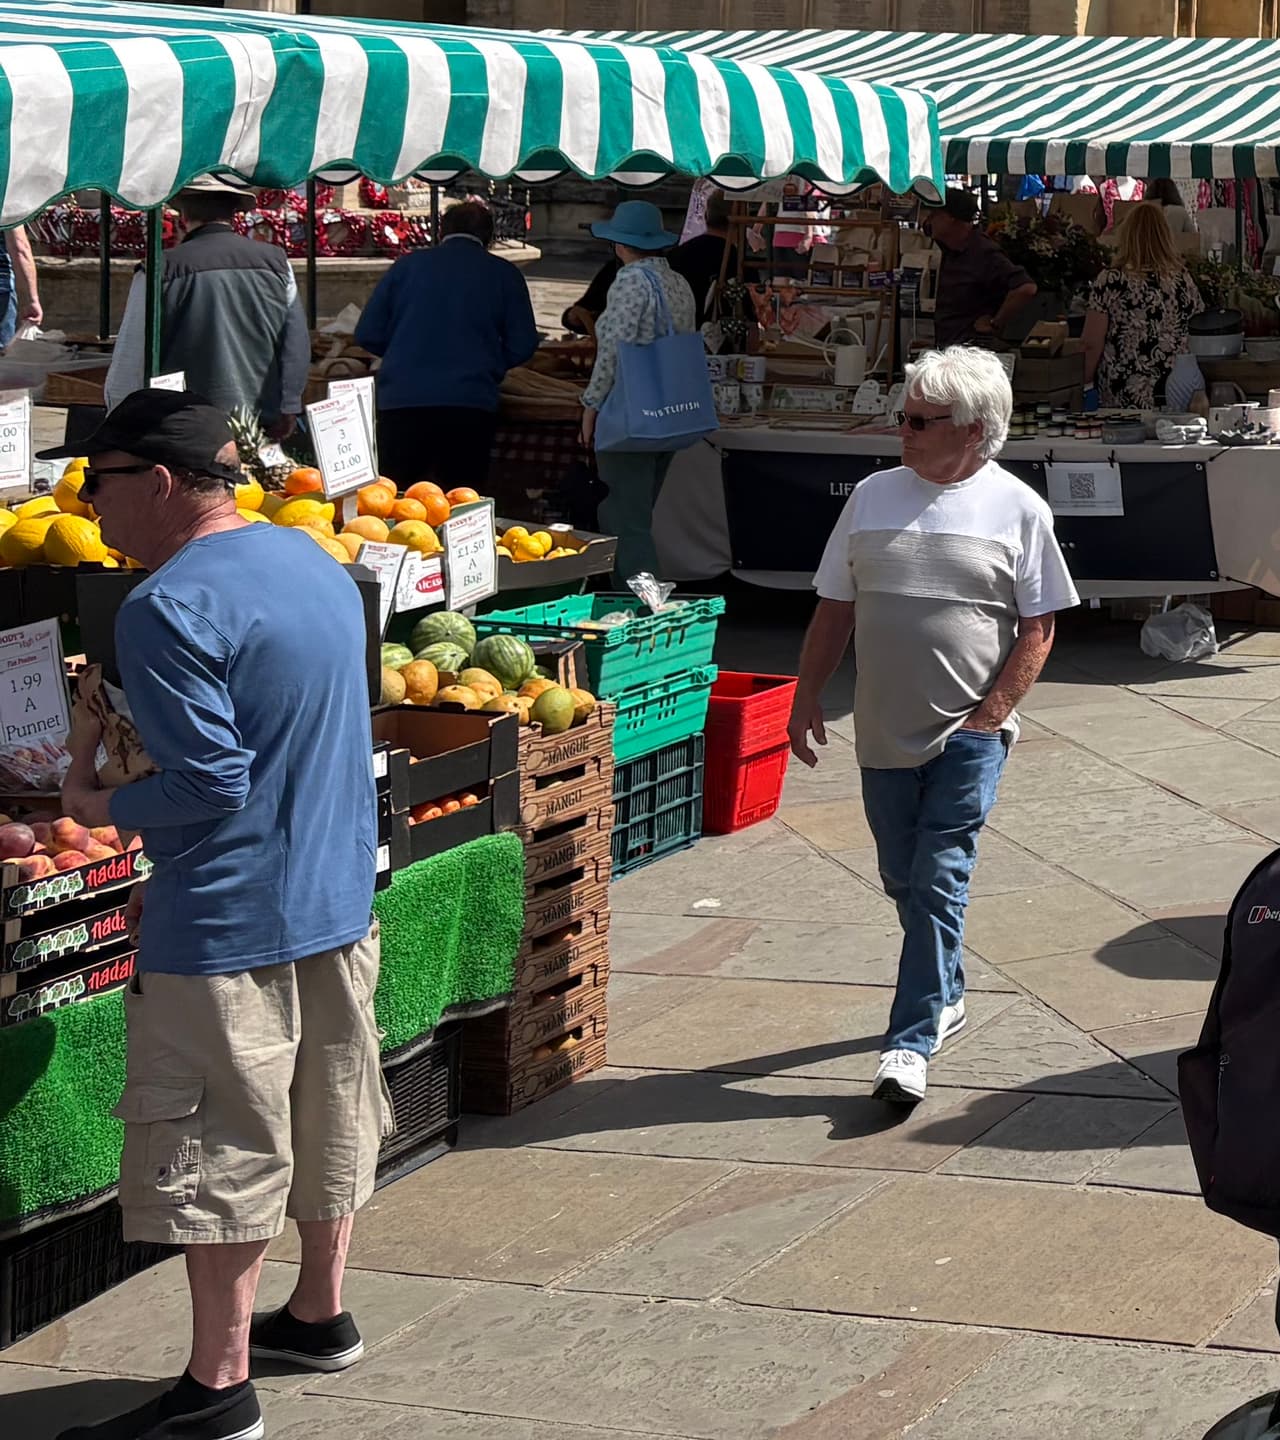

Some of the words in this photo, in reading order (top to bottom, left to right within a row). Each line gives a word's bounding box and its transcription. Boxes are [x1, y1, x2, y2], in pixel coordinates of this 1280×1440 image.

[339, 429, 346, 440] 3
[337, 442, 353, 456] for
[332, 454, 361, 473] £1.00
[829, 482, 857, 496] LIF
[457, 539, 486, 558] £1.50
[468, 559, 477, 570] A
[463, 573, 482, 588] Bag
[10, 672, 42, 694] 1.99
[25, 697, 37, 713] A
[5, 714, 61, 741] Punnet
[544, 735, 590, 767] MANGUE
[544, 788, 583, 817] MANGO
[541, 838, 587, 872] MANGUE
[86, 853, 133, 888] nadal
[541, 893, 584, 926] MANGUE
[88, 954, 135, 991] nadal
[542, 946, 580, 978] MANGO
